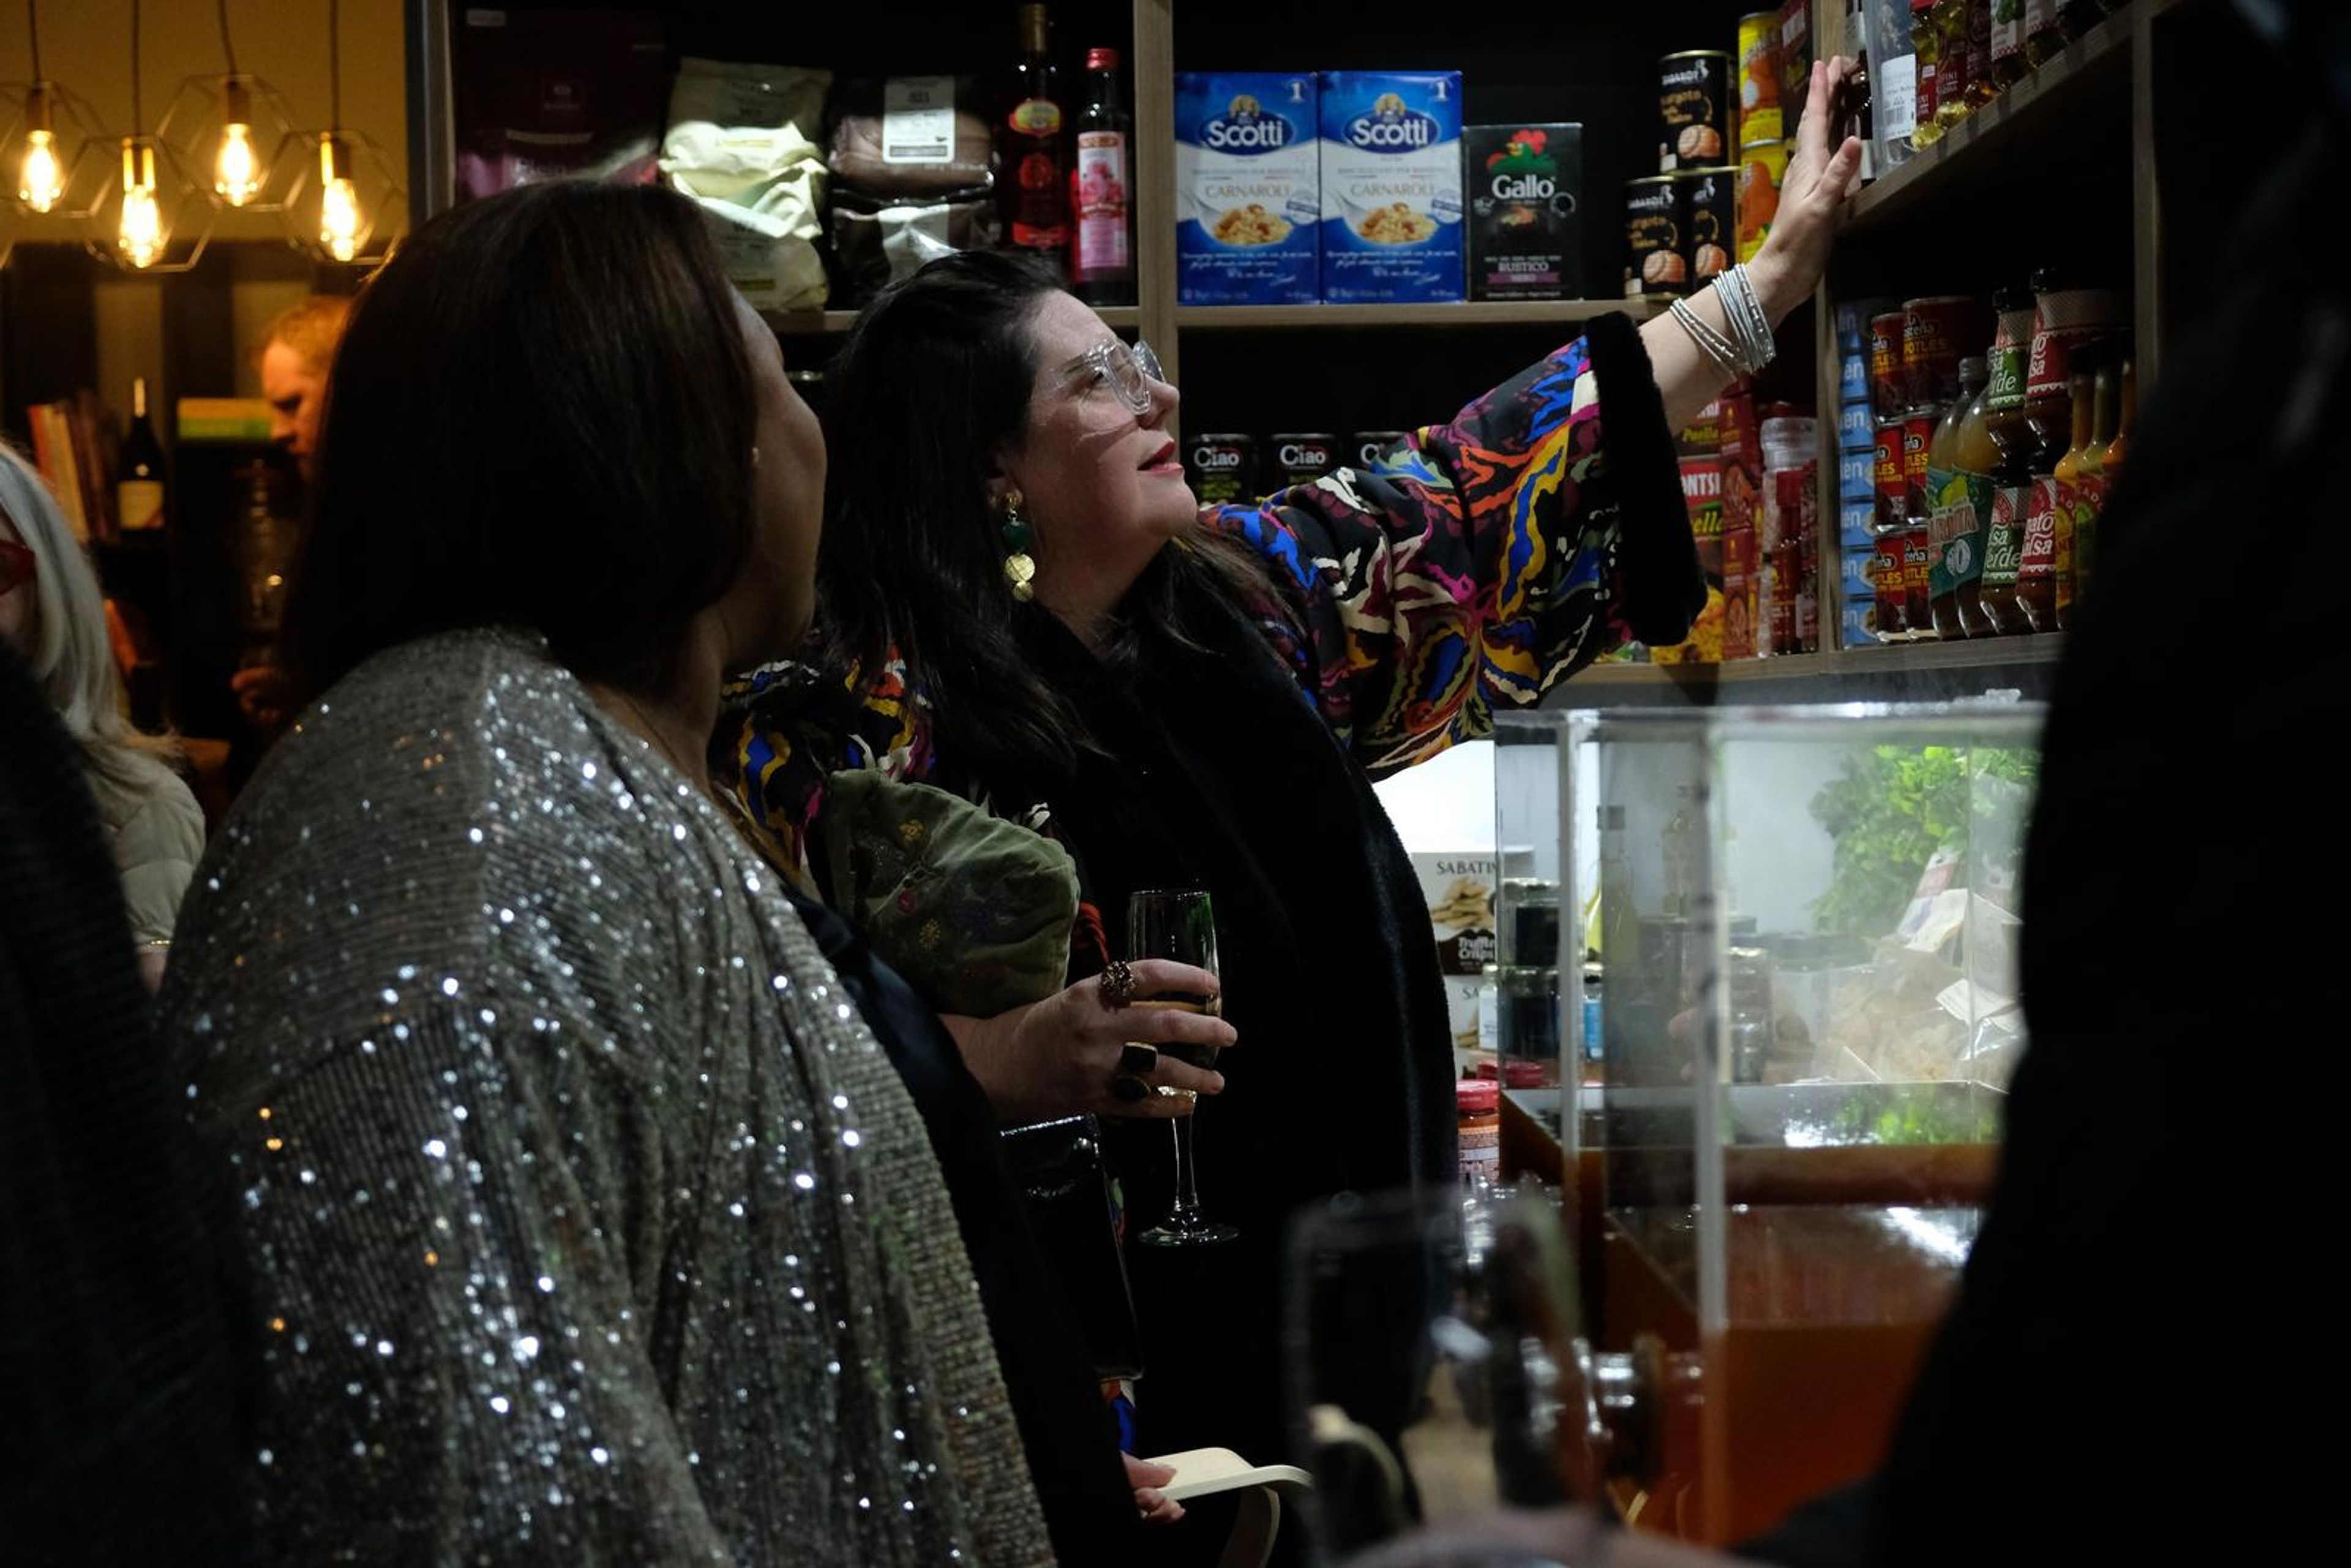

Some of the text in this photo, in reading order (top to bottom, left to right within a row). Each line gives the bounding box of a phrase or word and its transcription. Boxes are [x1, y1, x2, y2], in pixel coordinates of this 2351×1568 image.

[1290, 82, 1305, 102] 1
[1434, 81, 1447, 102] 1
[1207, 120, 1283, 148] Scotti
[1352, 118, 1428, 147] Scotti
[1205, 184, 1289, 198] CARNAROLI
[1350, 182, 1434, 196] CARNAROLI
[1491, 174, 1554, 199] Gallo
[1498, 261, 1550, 271] RUSTICO
[1839, 312, 1856, 332] en
[1843, 361, 1865, 379] en
[1843, 411, 1864, 428] en
[1194, 446, 1240, 468] Ciao
[1279, 445, 1327, 465] Ciao
[1843, 461, 1863, 479] en
[1842, 510, 1861, 528] en
[1842, 559, 1858, 576] en
[1842, 609, 1858, 625] en
[1437, 860, 1496, 874] SABATIN
